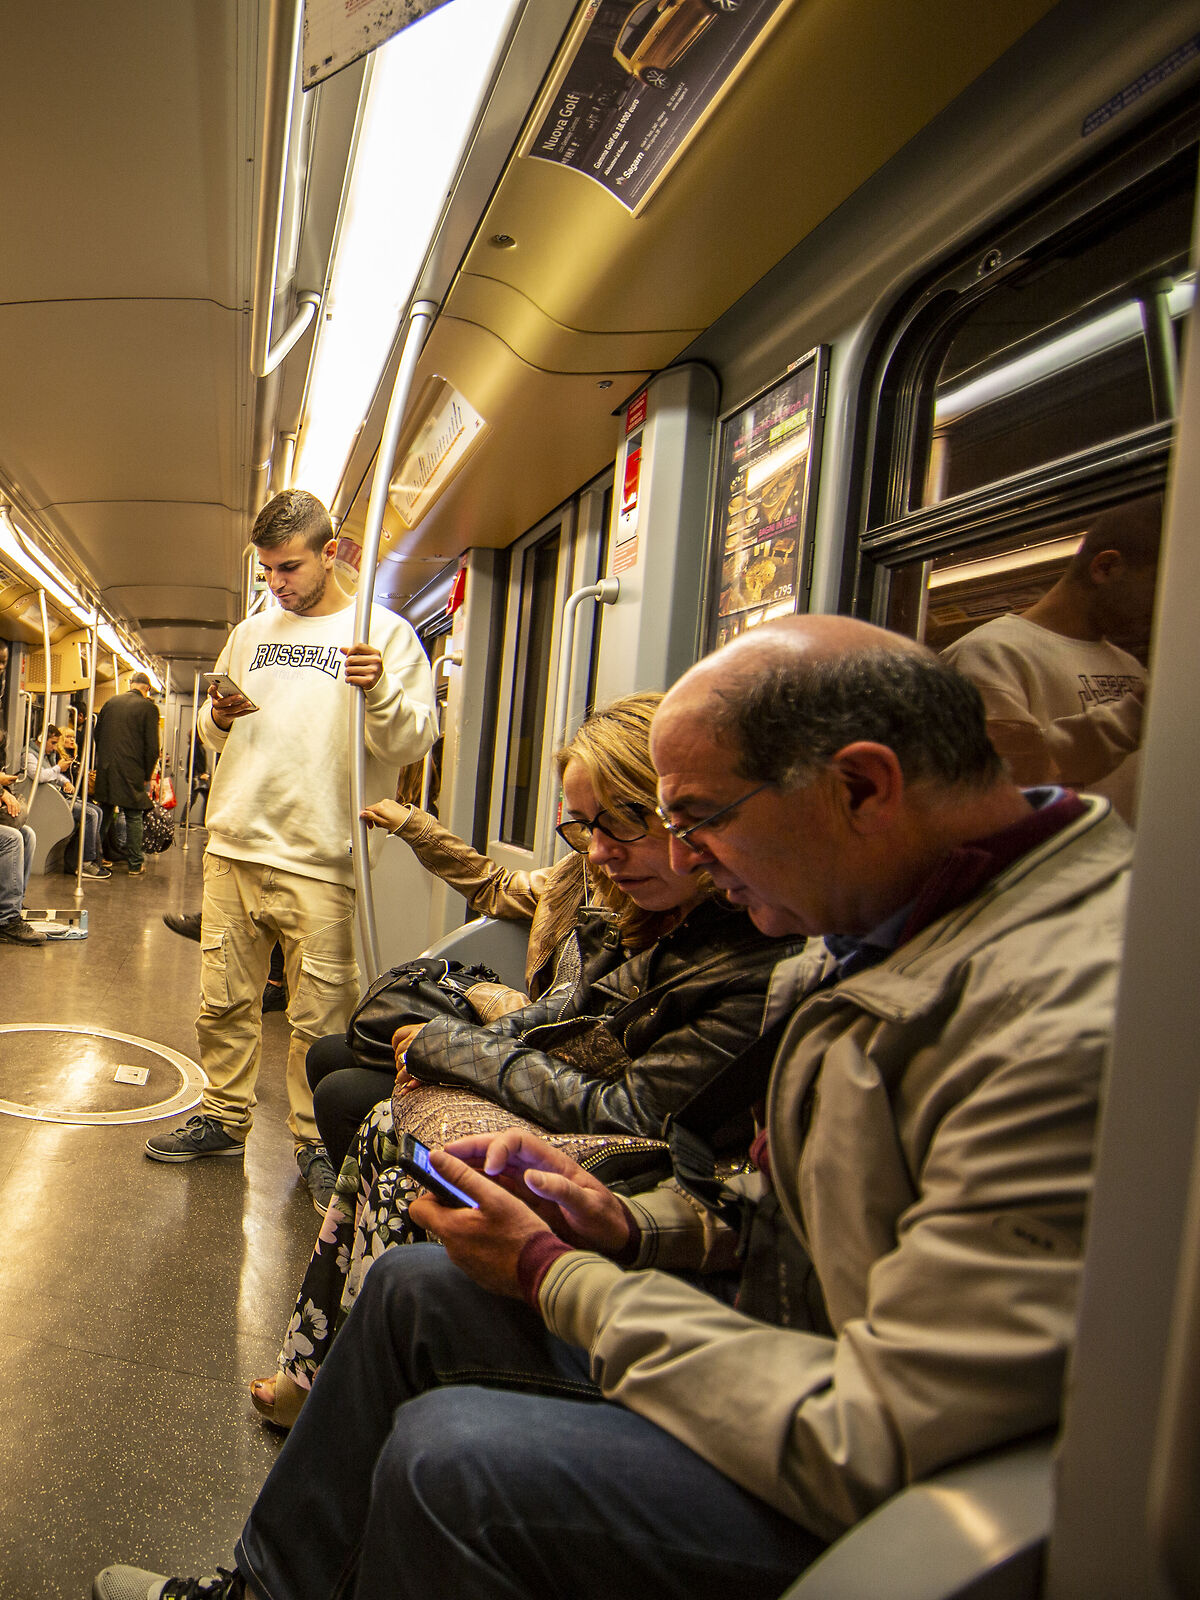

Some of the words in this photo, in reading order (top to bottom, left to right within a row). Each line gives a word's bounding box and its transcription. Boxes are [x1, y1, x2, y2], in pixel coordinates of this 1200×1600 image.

[542, 120, 569, 151] Nuova
[559, 93, 580, 118] Golf
[593, 150, 609, 169] Gamma
[604, 138, 615, 151] Golf
[612, 131, 620, 140] da
[616, 111, 632, 132] 18.900
[629, 99, 639, 113] euro
[623, 151, 645, 179] Sagam
[249, 644, 341, 680] RUSSELL
